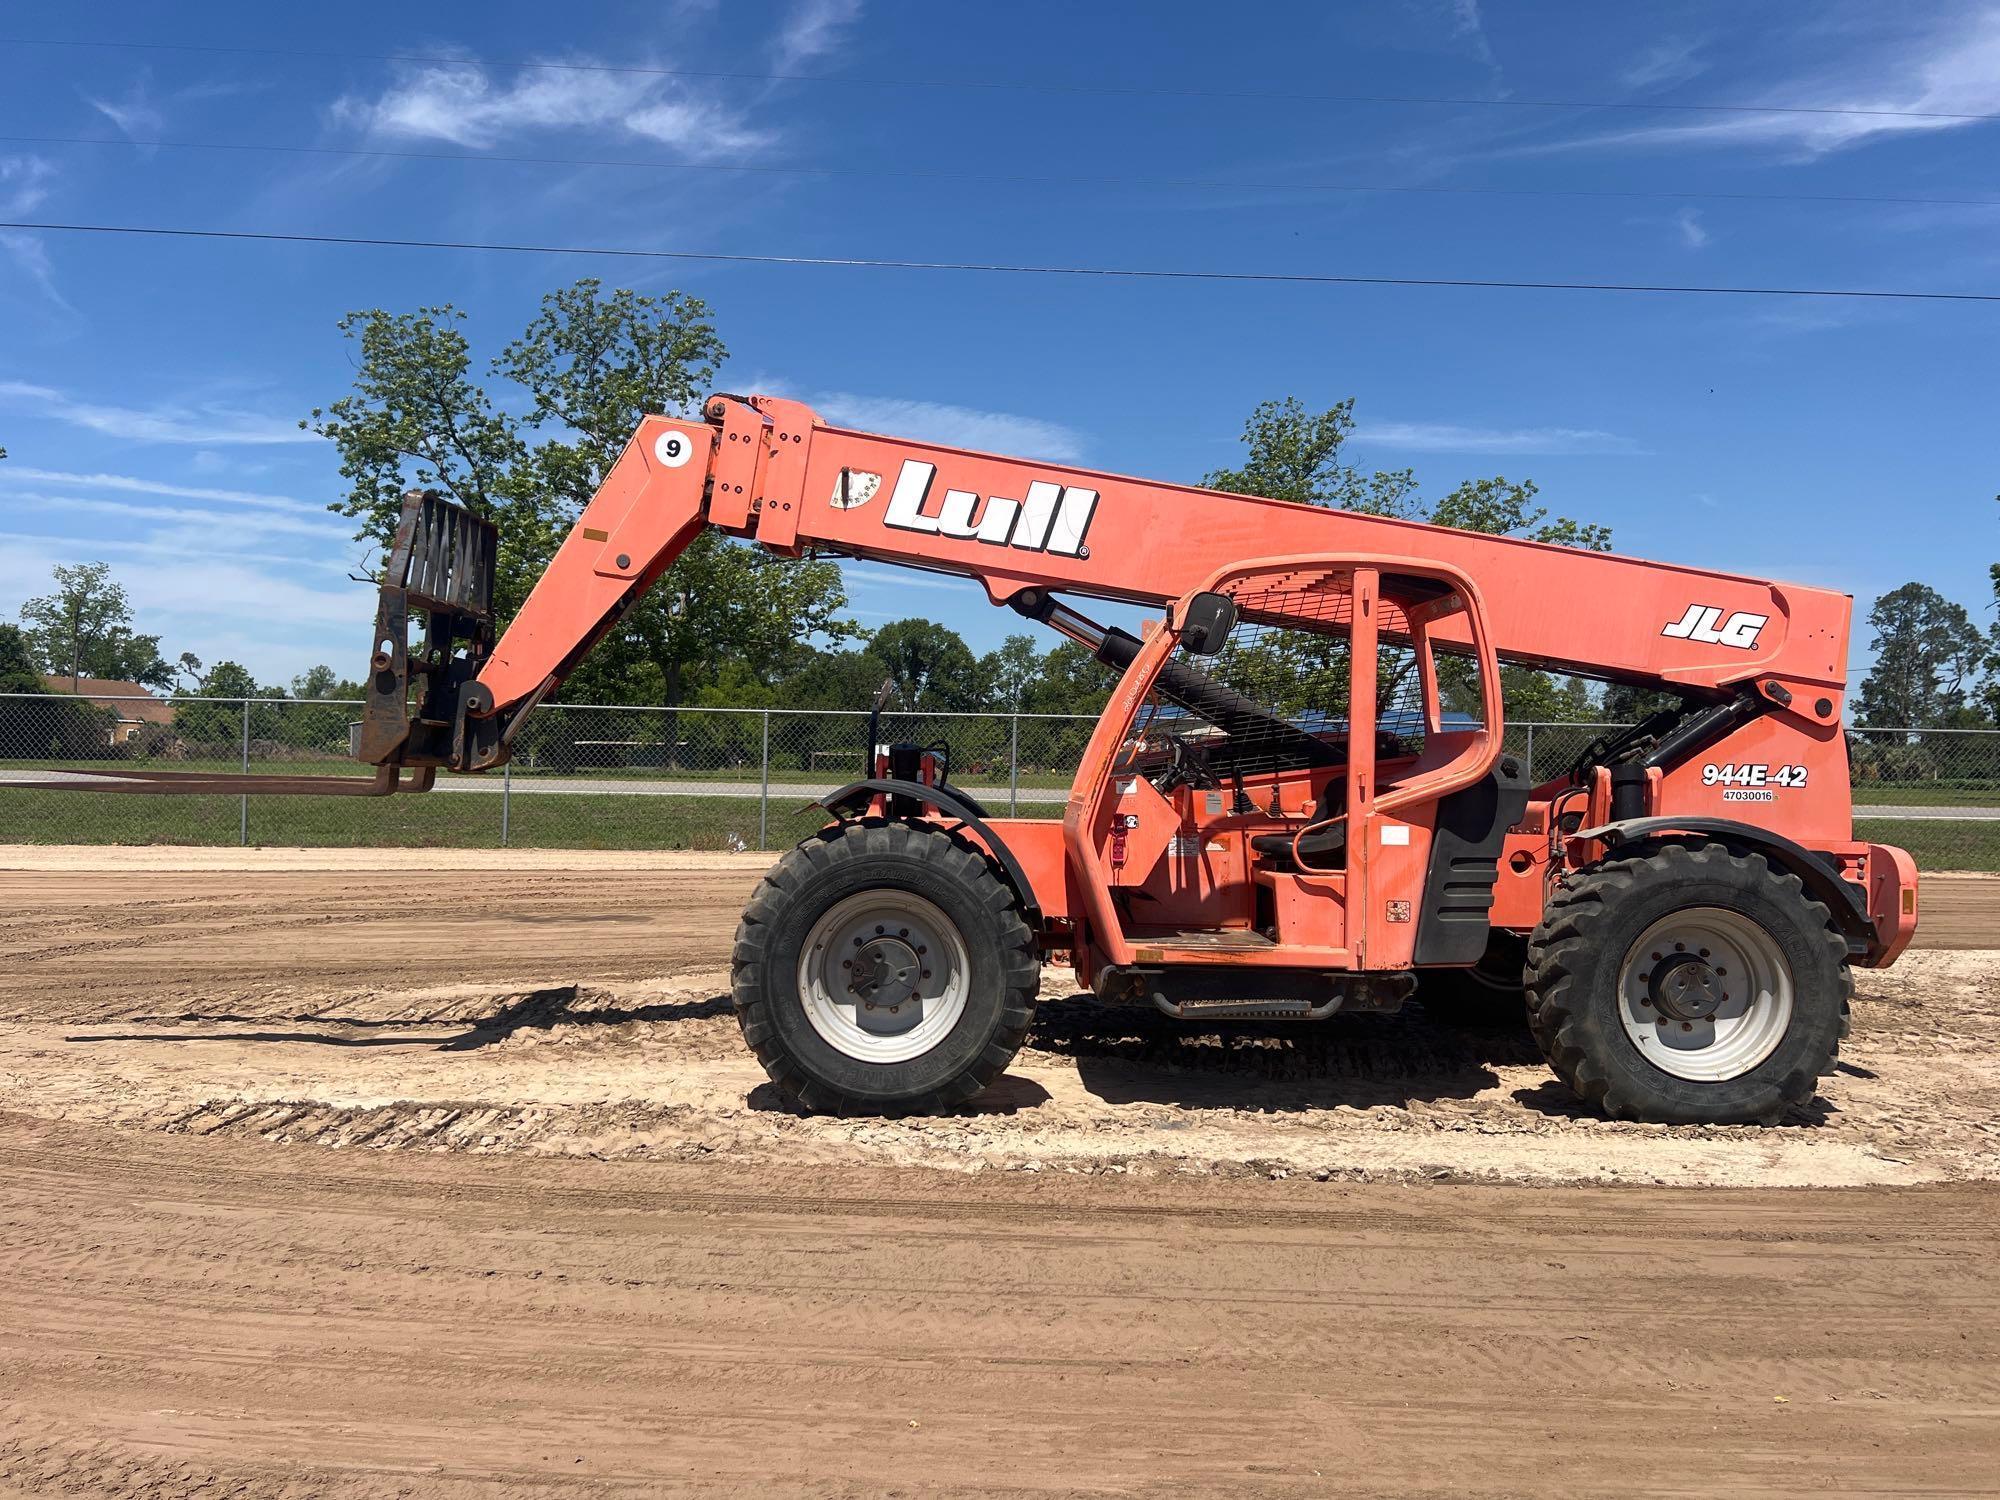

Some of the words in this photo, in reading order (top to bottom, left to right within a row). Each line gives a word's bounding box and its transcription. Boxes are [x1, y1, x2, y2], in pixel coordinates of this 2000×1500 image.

[666, 440, 681, 457] 9
[883, 459, 1101, 559] Lull
[1660, 604, 1769, 650] JLG
[1702, 764, 1808, 788] 944E-42
[1723, 791, 1772, 801] 47030016
